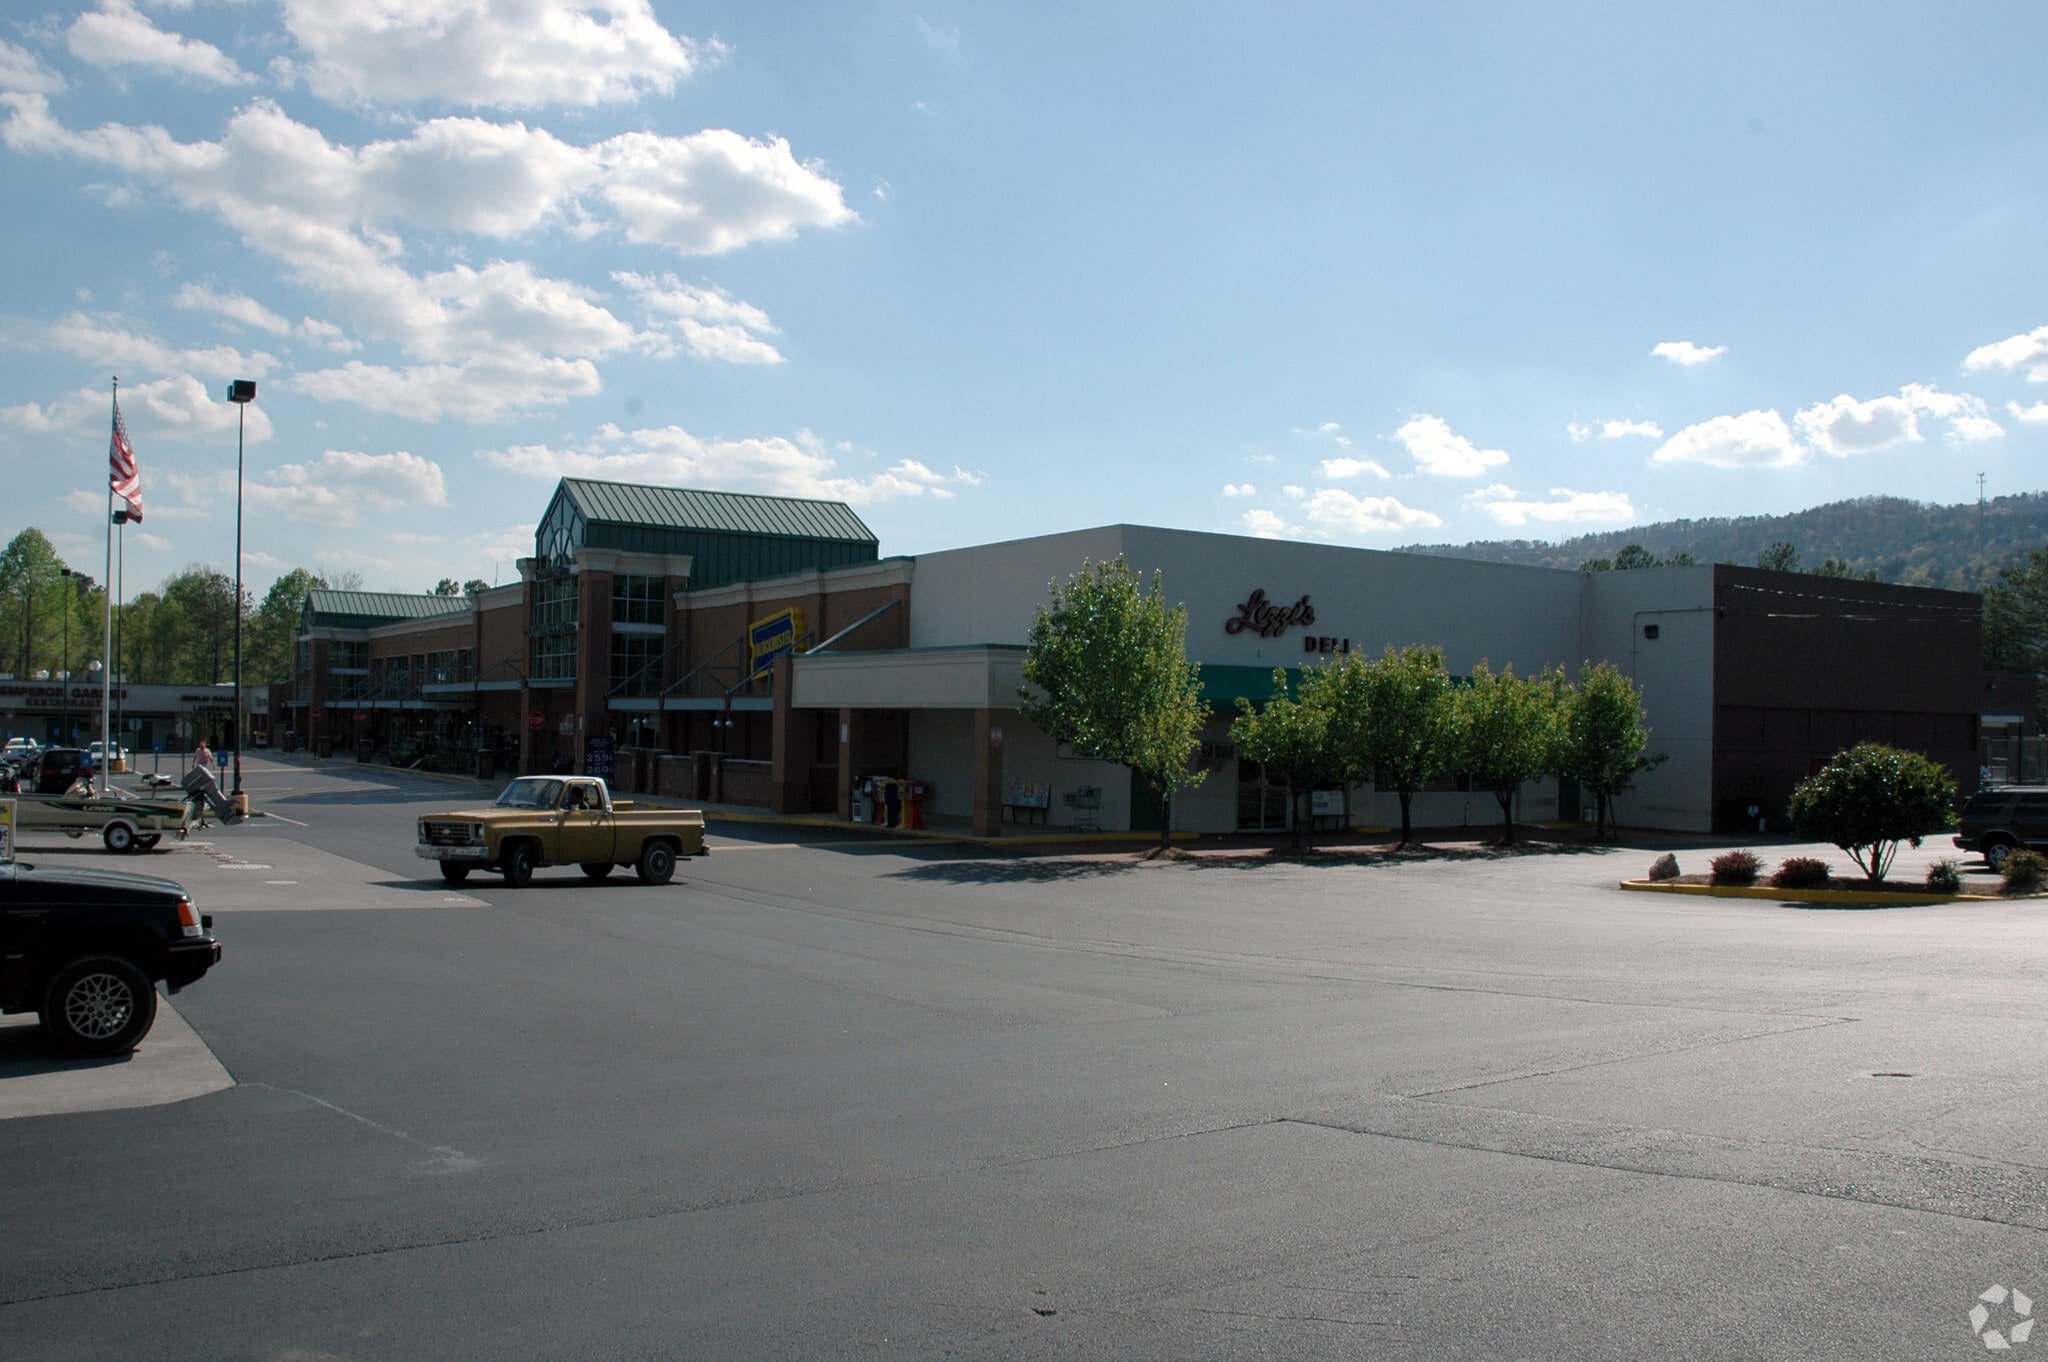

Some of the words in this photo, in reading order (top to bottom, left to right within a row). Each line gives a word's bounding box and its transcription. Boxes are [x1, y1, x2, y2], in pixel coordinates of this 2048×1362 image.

[1304, 635, 1350, 654] DELI
[0, 686, 65, 697] EMPEROR
[25, 698, 101, 707] RESTAURANT
